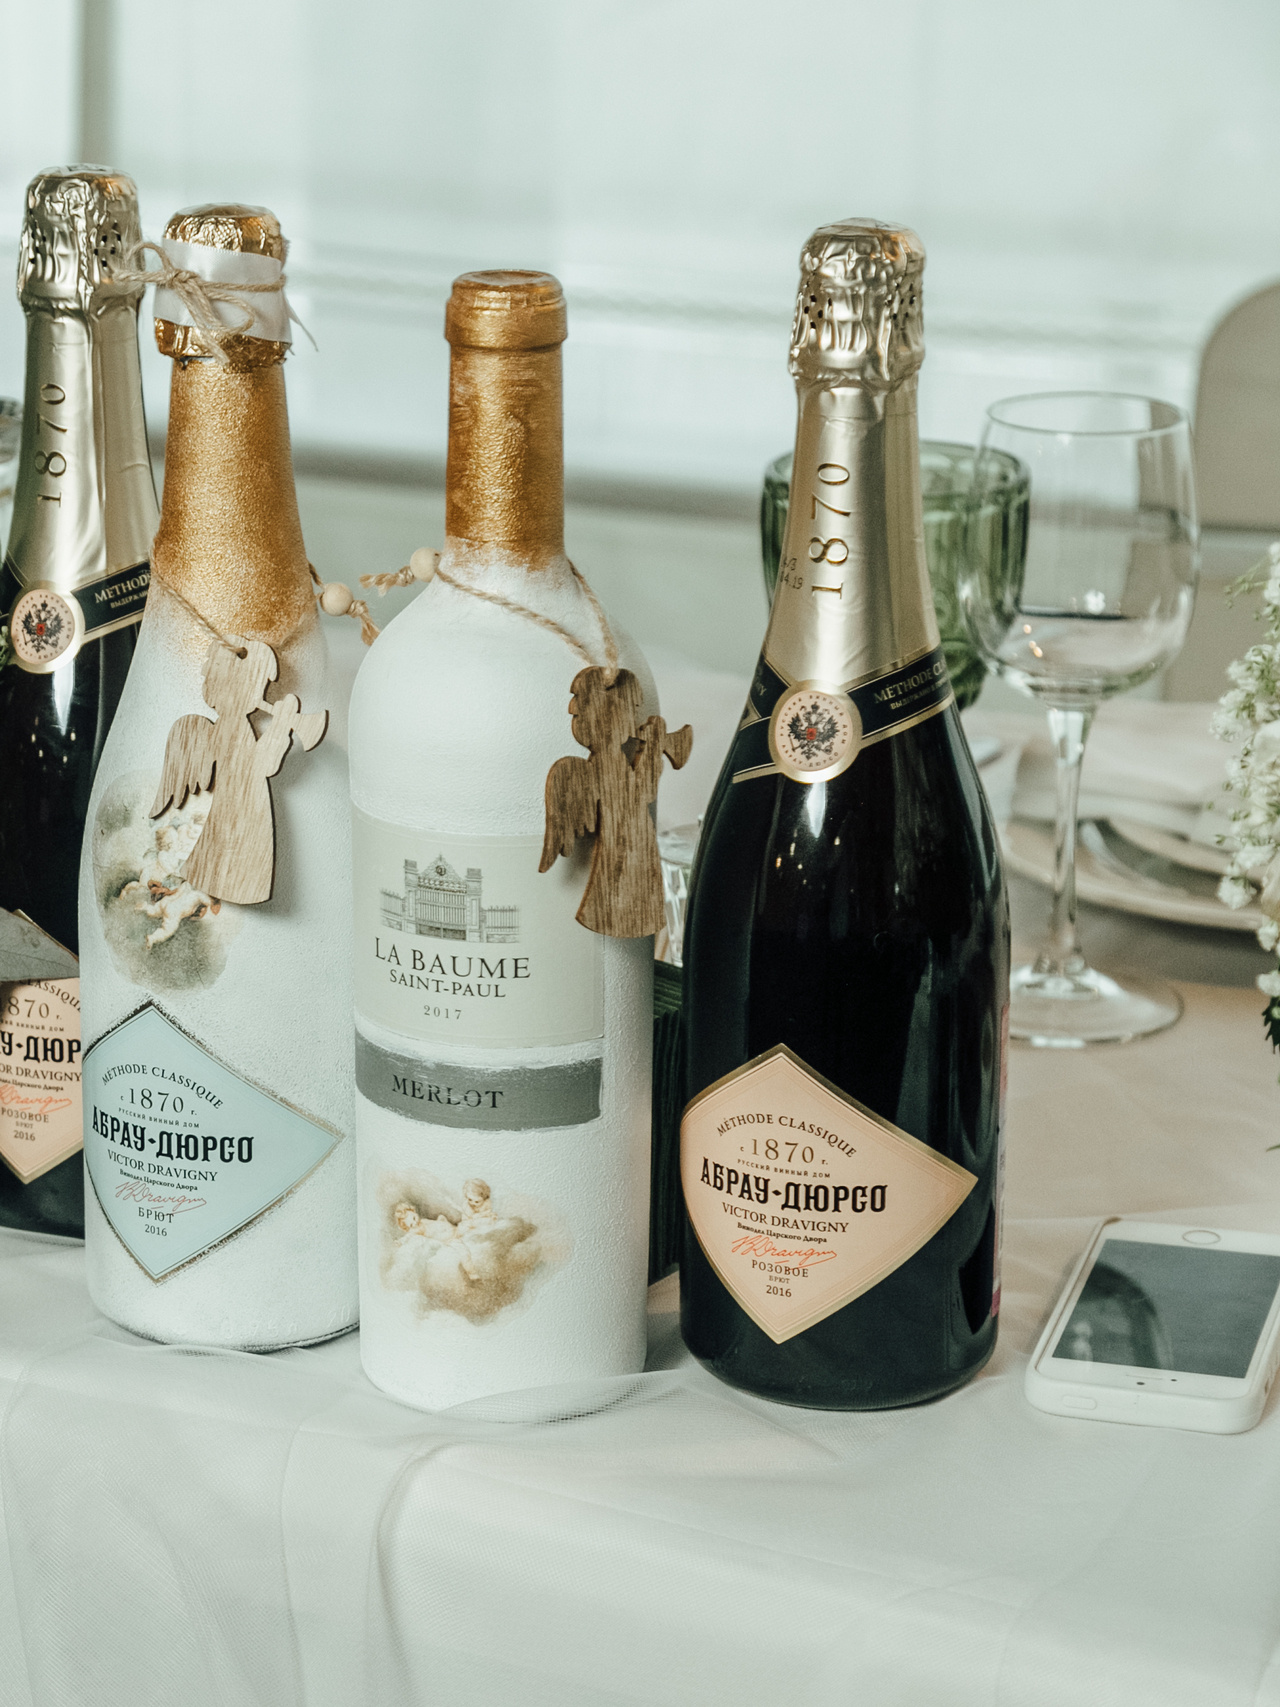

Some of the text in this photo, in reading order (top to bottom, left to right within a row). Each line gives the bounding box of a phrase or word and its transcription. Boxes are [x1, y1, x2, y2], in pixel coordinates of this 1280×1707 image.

[35, 383, 67, 507] 1870
[808, 463, 851, 599] 1870
[375, 937, 532, 980] LA BAUME
[389, 969, 507, 999] SAINT-PAUL
[423, 1004, 462, 1020] 2017
[16, 1066, 82, 1082] DRAVIGNY
[129, 1088, 184, 1113] 1870
[152, 1067, 223, 1110] CLASSIQUE
[392, 1074, 504, 1109] MERLOT
[1, 1107, 50, 1123] РОЗОВОЕ
[13, 1130, 36, 1141] 2016
[92, 1105, 254, 1163] АБРАУ-ДЮРСО
[778, 1115, 857, 1158] CLASSIQUE
[751, 1138, 815, 1164] 1870
[108, 1149, 218, 1182] VICTOR DRAVIGNY
[144, 1176, 175, 1188] Царского
[176, 1183, 198, 1192] Двора
[700, 1156, 888, 1214] АБРАУ-ДЮРСО
[138, 1207, 174, 1223] БРЮТ
[722, 1202, 849, 1233] VICTOR DRAVIGNY
[144, 1224, 167, 1237] 2016
[738, 1222, 827, 1244] Винодел Царского Двора
[752, 1259, 809, 1278] РОЗОВОЕ
[769, 1275, 791, 1284] БРЮТ
[766, 1285, 792, 1298] 2016
